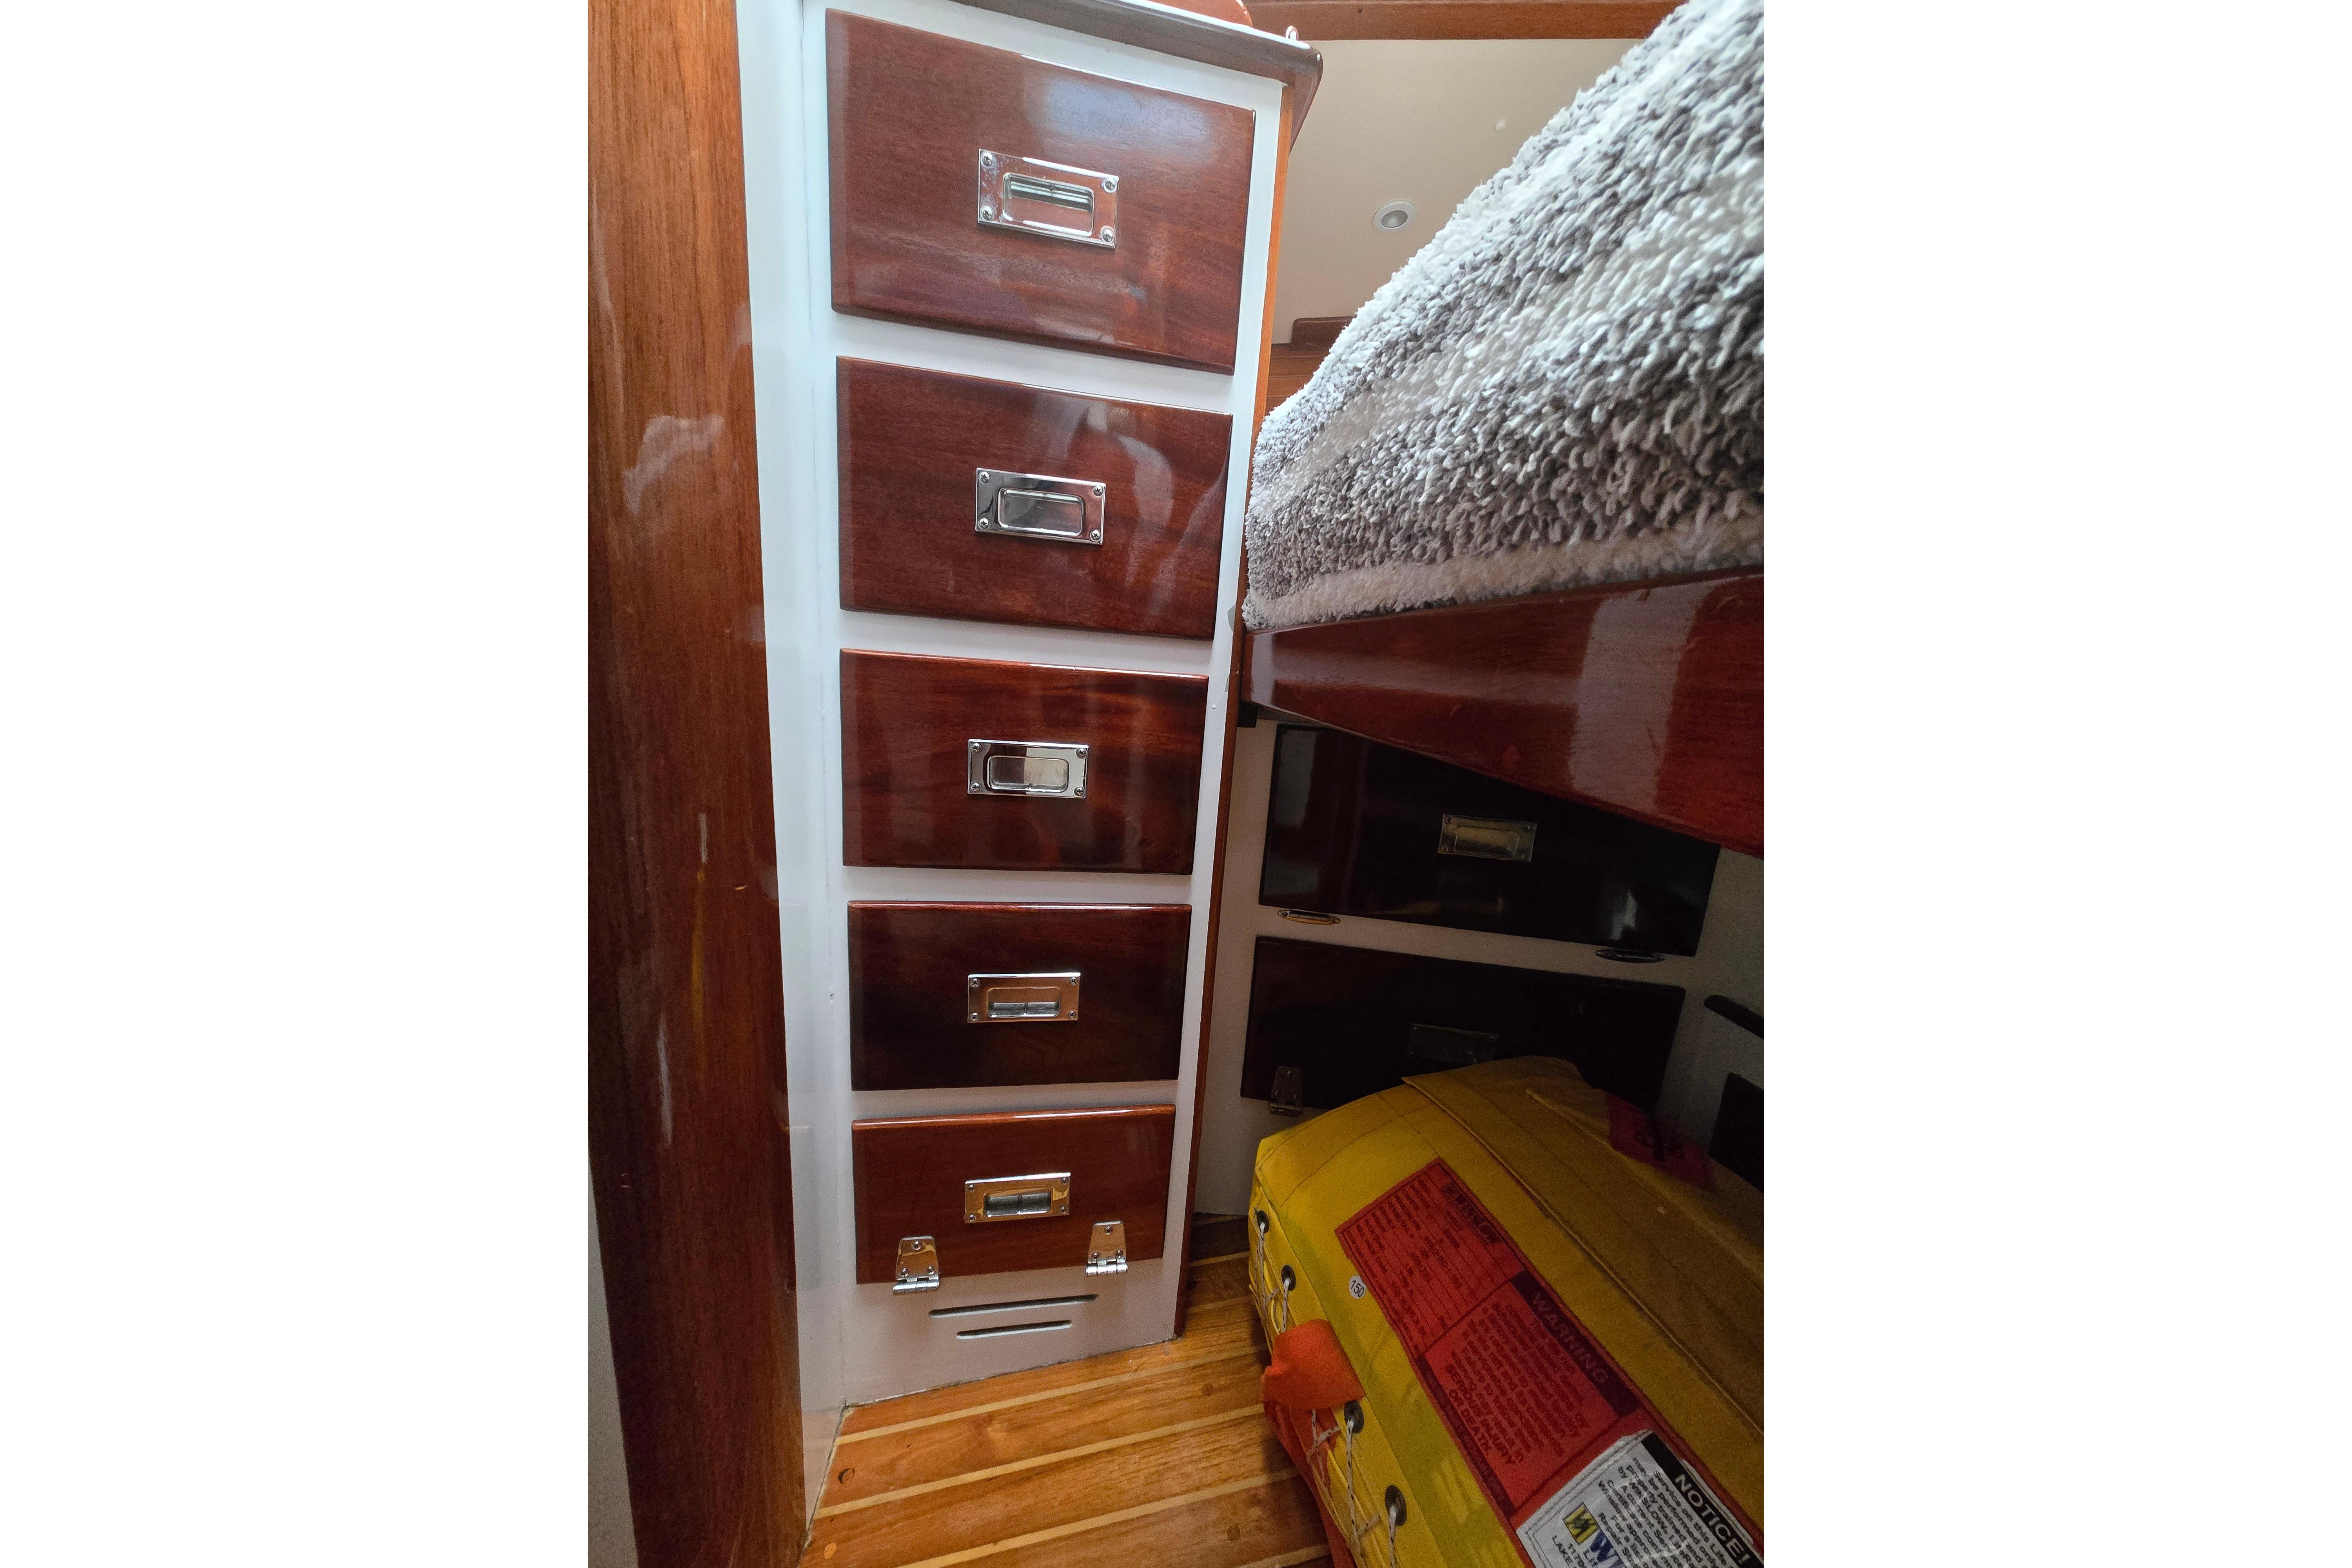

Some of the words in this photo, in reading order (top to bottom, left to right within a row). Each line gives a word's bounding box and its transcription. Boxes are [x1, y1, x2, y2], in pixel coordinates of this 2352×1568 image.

[1350, 1280, 1365, 1298] 150
[1529, 1291, 1610, 1387] WARNING
[1459, 1347, 1487, 1384] Failure
[1483, 1382, 1495, 1397] to
[1445, 1362, 1485, 1419] SERIOUS
[1479, 1416, 1516, 1469] INJURY
[1447, 1387, 1465, 1409] OR
[1615, 1465, 1630, 1481] by
[1595, 1480, 1630, 1523] Winslow
[1604, 1478, 1646, 1530] Certificate
[1620, 1483, 1629, 1493] A
[1625, 1492, 1656, 1530] current
[1652, 1528, 1686, 1568] Service
[1624, 1464, 1660, 1506] properly
[1655, 1504, 1688, 1543] trained
[1684, 1541, 1704, 1564] and
[1629, 1457, 1649, 1479] may
[1647, 1476, 1661, 1492] be
[1656, 1490, 1702, 1546] performed
[1651, 1469, 1684, 1508] Service
[1681, 1507, 1694, 1522] on
[1692, 1521, 1712, 1544] this
[1708, 1542, 1730, 1567] Life
[1672, 1472, 1752, 1566] NOTICE!
[1549, 1533, 1575, 1567] LAKE
[1596, 1511, 1625, 1547] Repair
[1609, 1514, 1626, 1535] For
[1623, 1534, 1631, 1543] a
[1629, 1542, 1646, 1562] list
